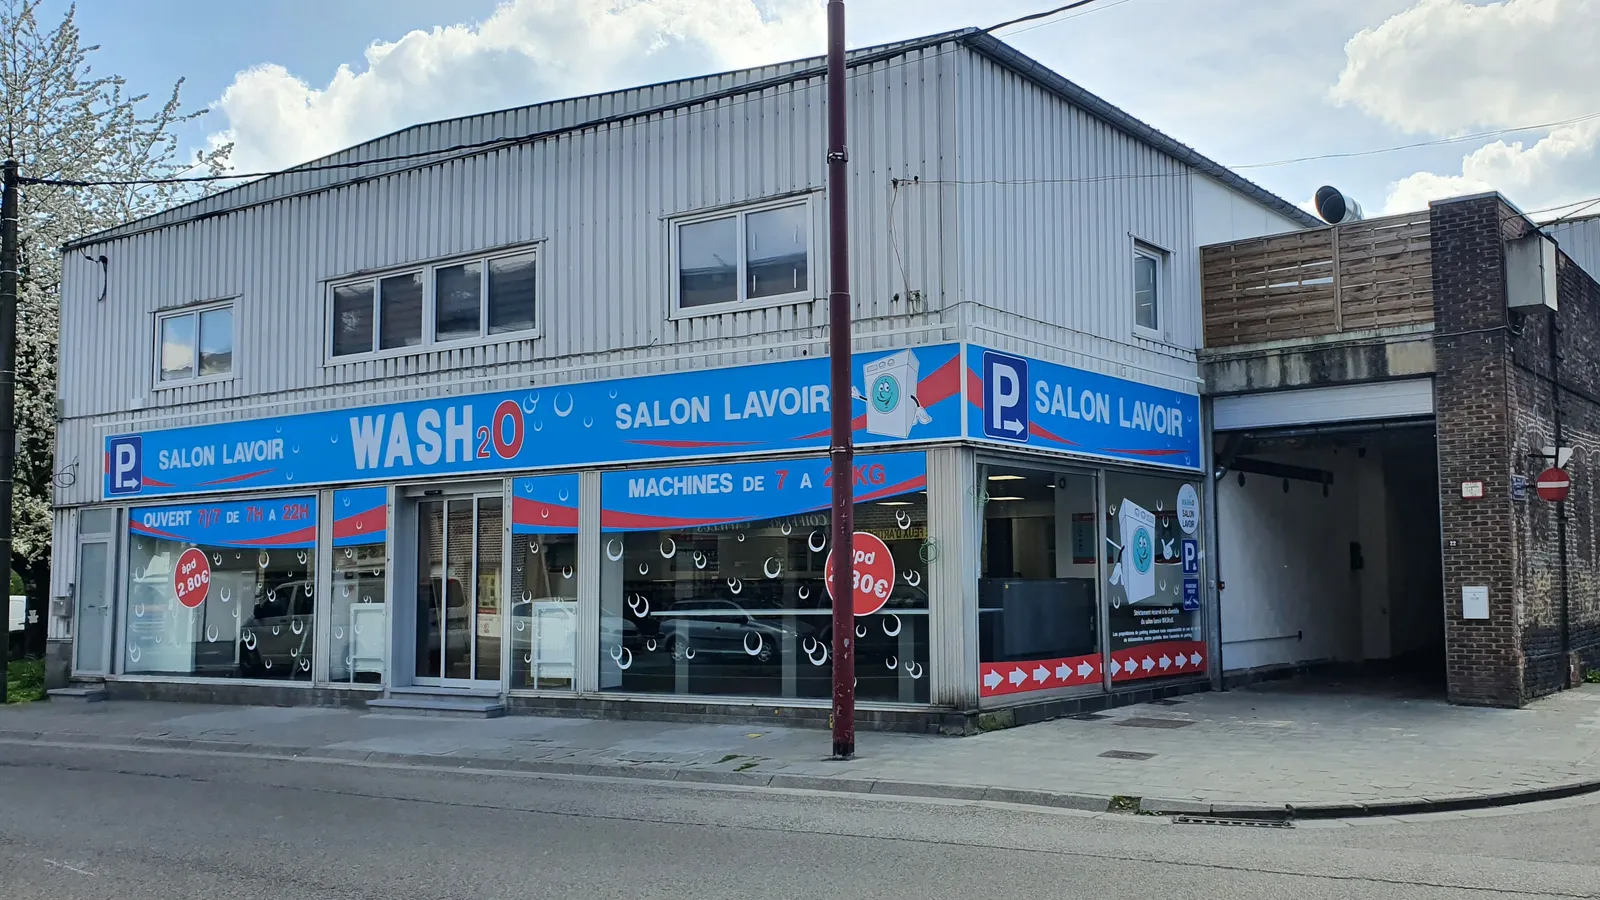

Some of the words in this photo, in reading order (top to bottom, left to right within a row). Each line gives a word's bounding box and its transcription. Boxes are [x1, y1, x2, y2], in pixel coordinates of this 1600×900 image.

[615, 396, 710, 430] SALON
[724, 384, 831, 421] LAVOIR
[992, 362, 1020, 430] P
[1035, 380, 1110, 424] SALON
[1119, 397, 1183, 437] LAVOIR
[115, 443, 136, 488] P
[159, 445, 215, 470] SALON
[222, 438, 284, 464] LAVOIR
[628, 472, 733, 498] MACHINES
[743, 476, 765, 493] DE
[775, 469, 789, 490] 7
[800, 475, 813, 489] A
[823, 463, 886, 488] 2KG
[143, 509, 192, 528] OUVERT
[226, 510, 240, 524] DE
[246, 505, 264, 522] 7H
[268, 508, 276, 521] A
[282, 503, 309, 521] 22H
[181, 557, 197, 576] àpd
[852, 548, 876, 565] pd
[1184, 542, 1195, 571] P
[177, 569, 210, 598] 2.80€
